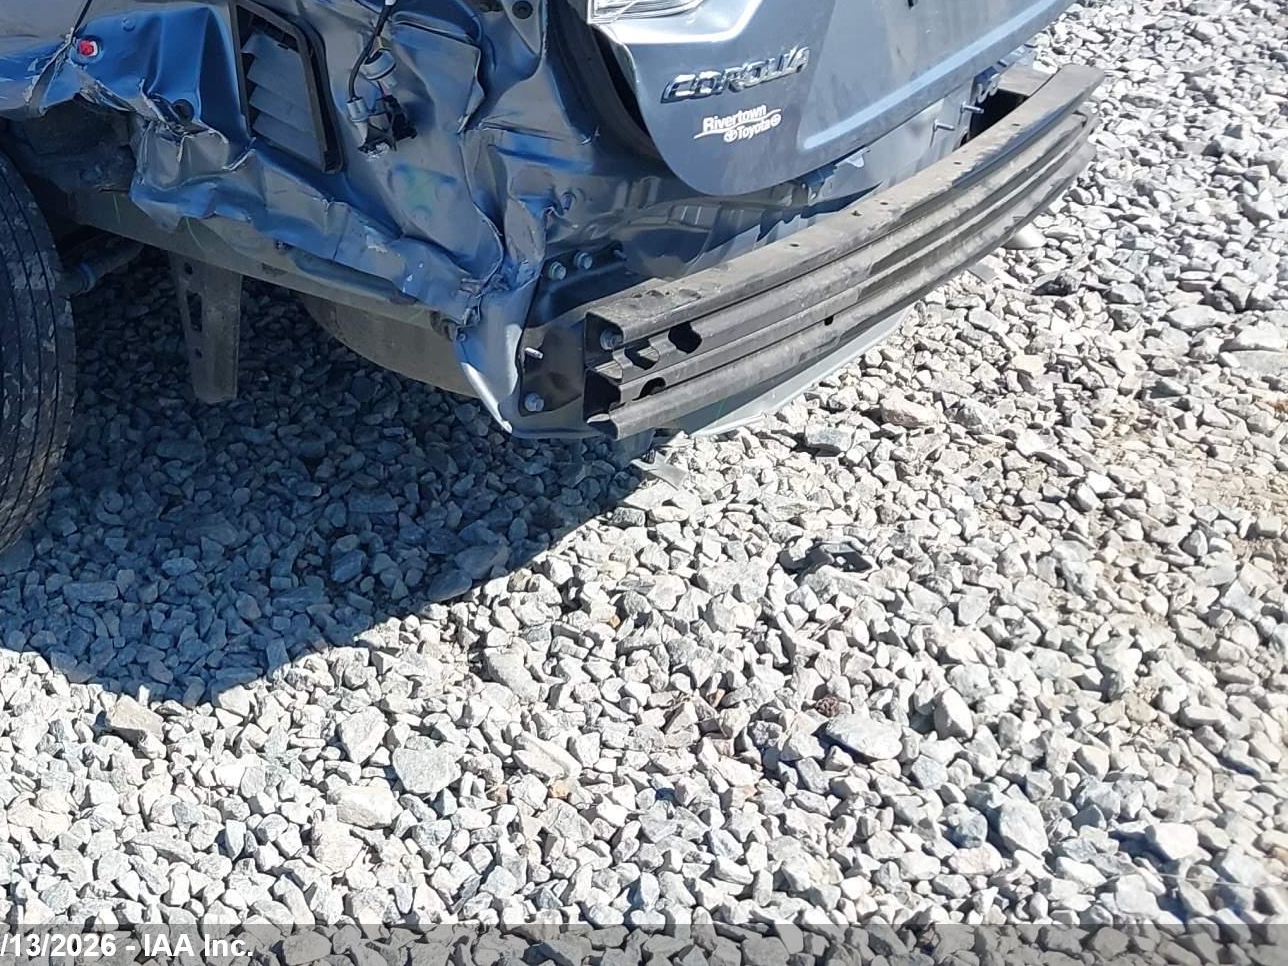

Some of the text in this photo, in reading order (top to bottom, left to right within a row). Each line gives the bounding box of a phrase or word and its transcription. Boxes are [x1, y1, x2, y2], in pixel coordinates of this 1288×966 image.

[660, 46, 810, 104] COROLLA
[702, 104, 767, 131] Rivertown
[736, 117, 771, 140] Toyota
